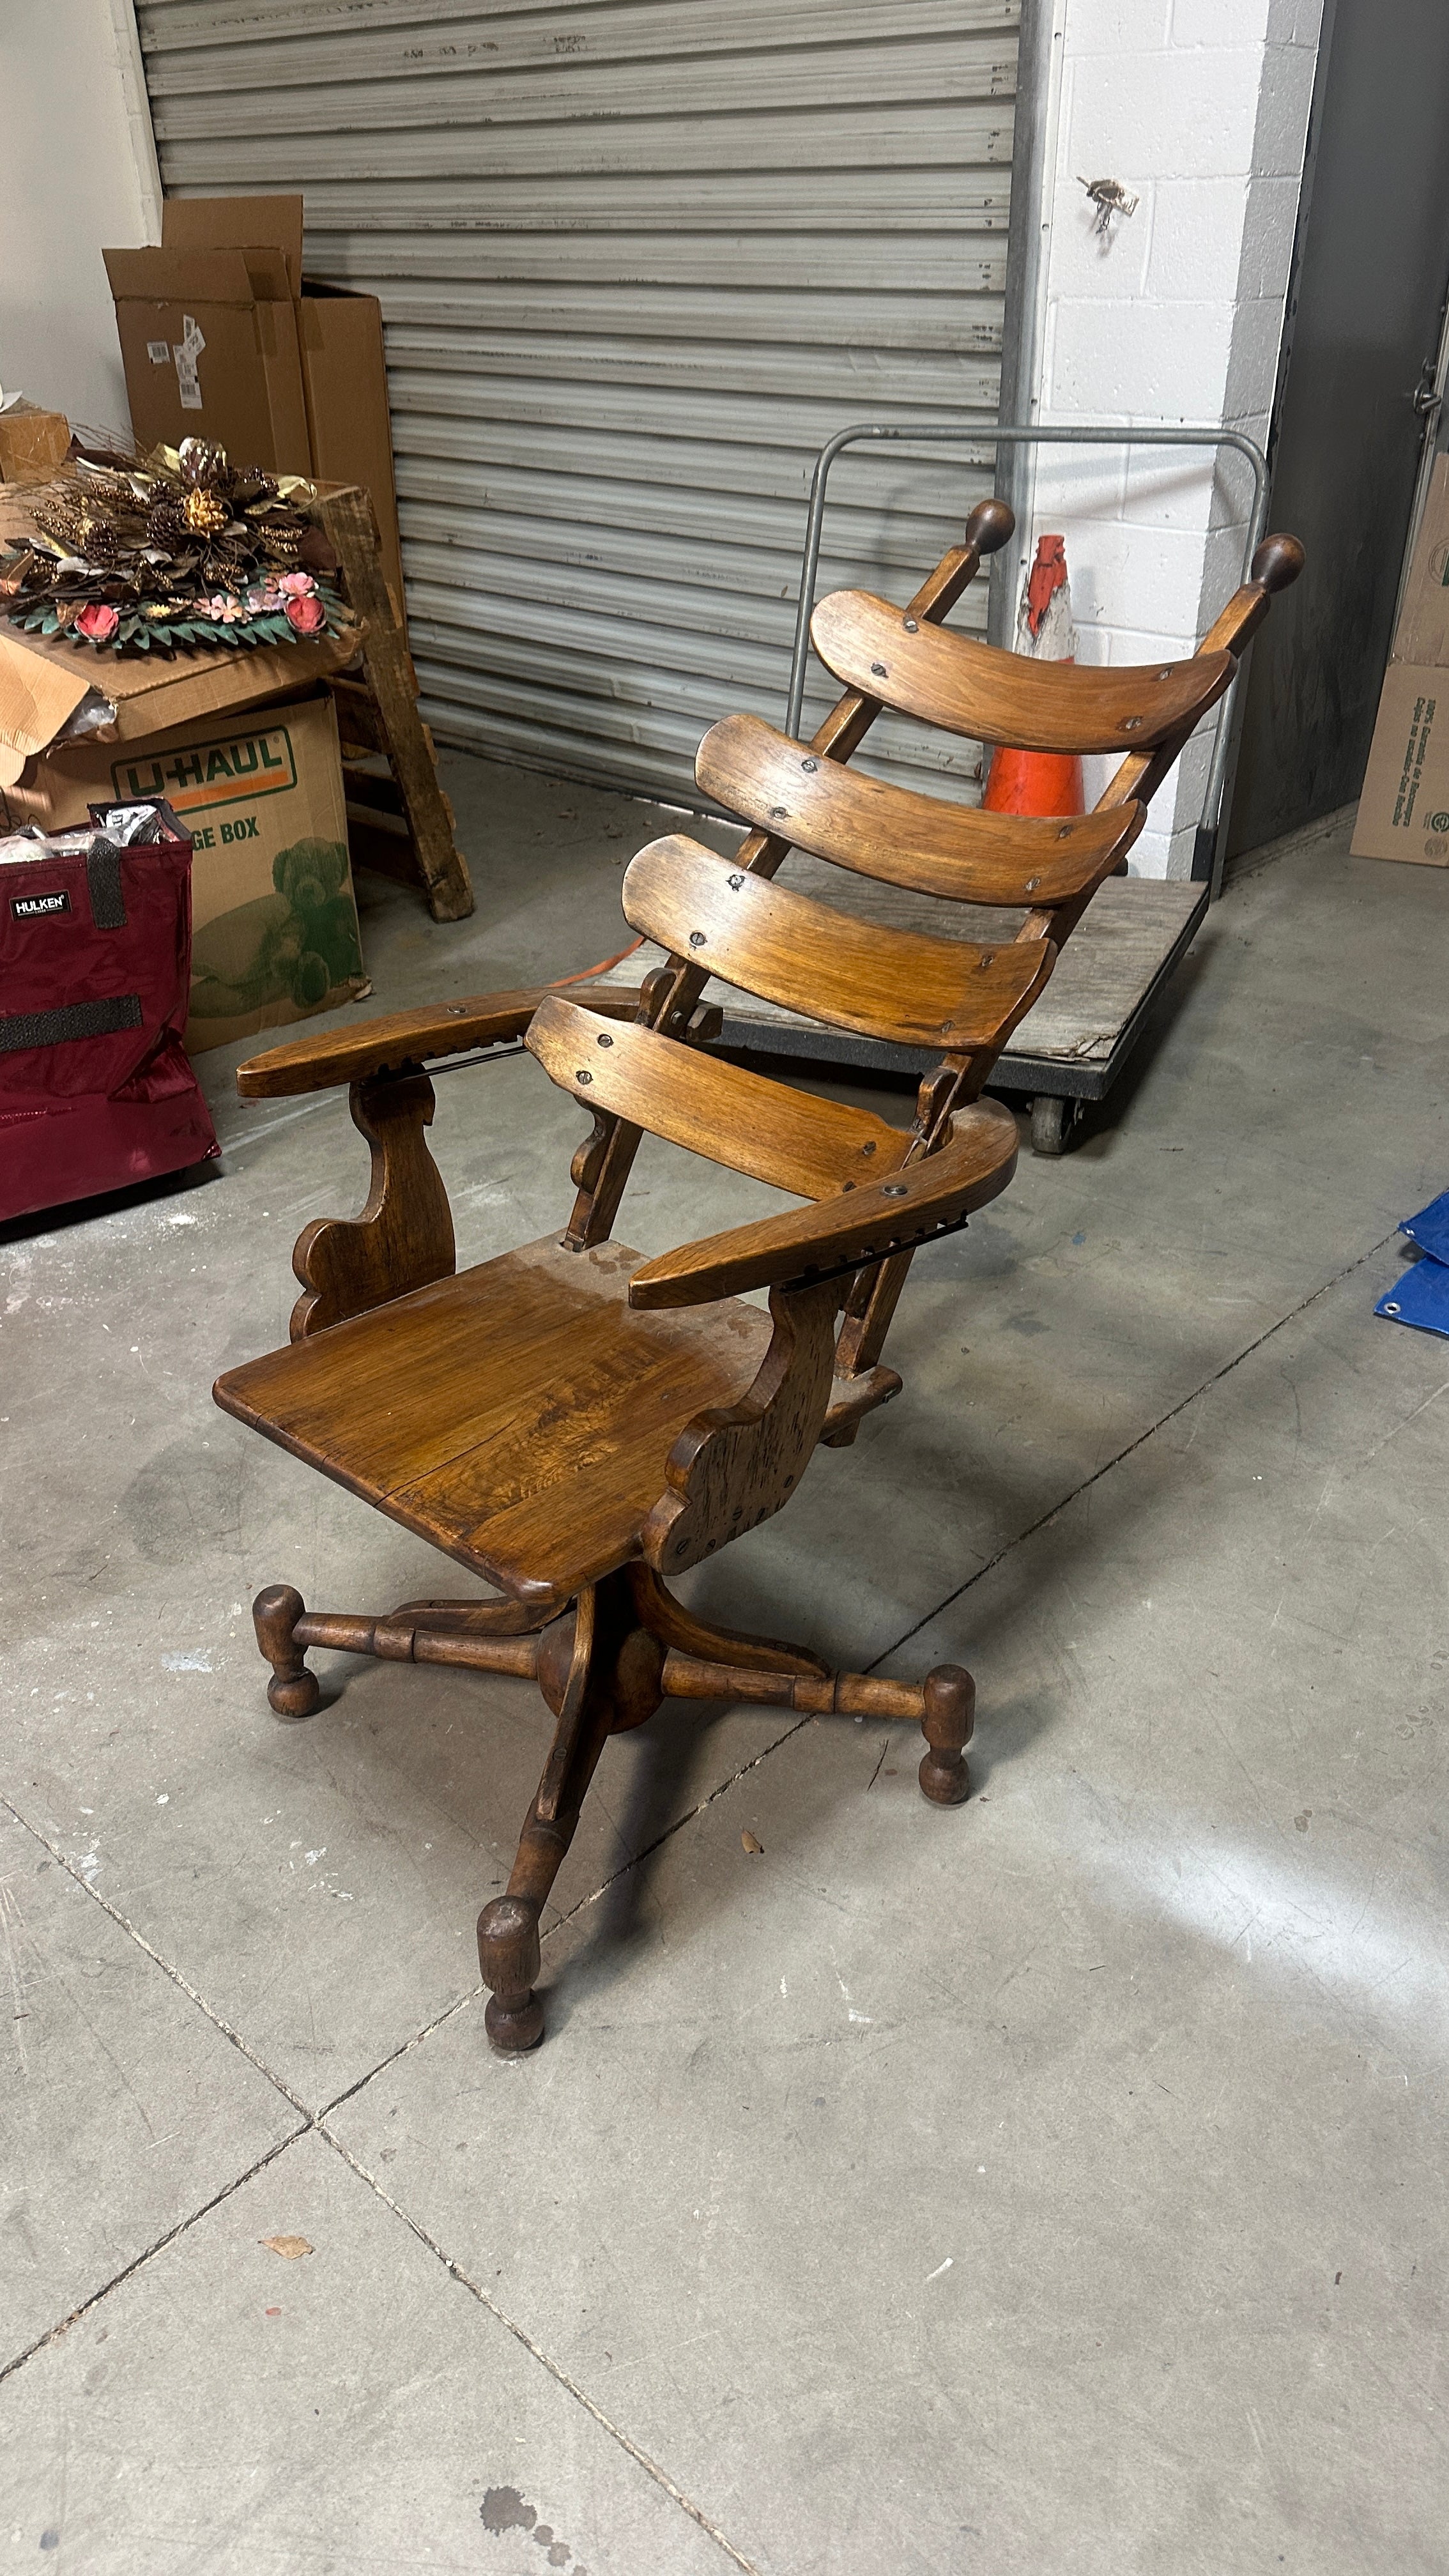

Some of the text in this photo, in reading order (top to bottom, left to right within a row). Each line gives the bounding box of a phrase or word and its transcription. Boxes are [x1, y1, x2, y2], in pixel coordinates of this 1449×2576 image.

[1413, 697, 1426, 723] Cajas
[1424, 699, 1436, 724] 100%
[1410, 724, 1418, 737] no
[1413, 767, 1422, 779] de
[1392, 795, 1406, 827] Recibo
[1402, 781, 1420, 827] Recompra
[192, 816, 260, 851] GE BOX
[15, 896, 63, 914] HULKEN
